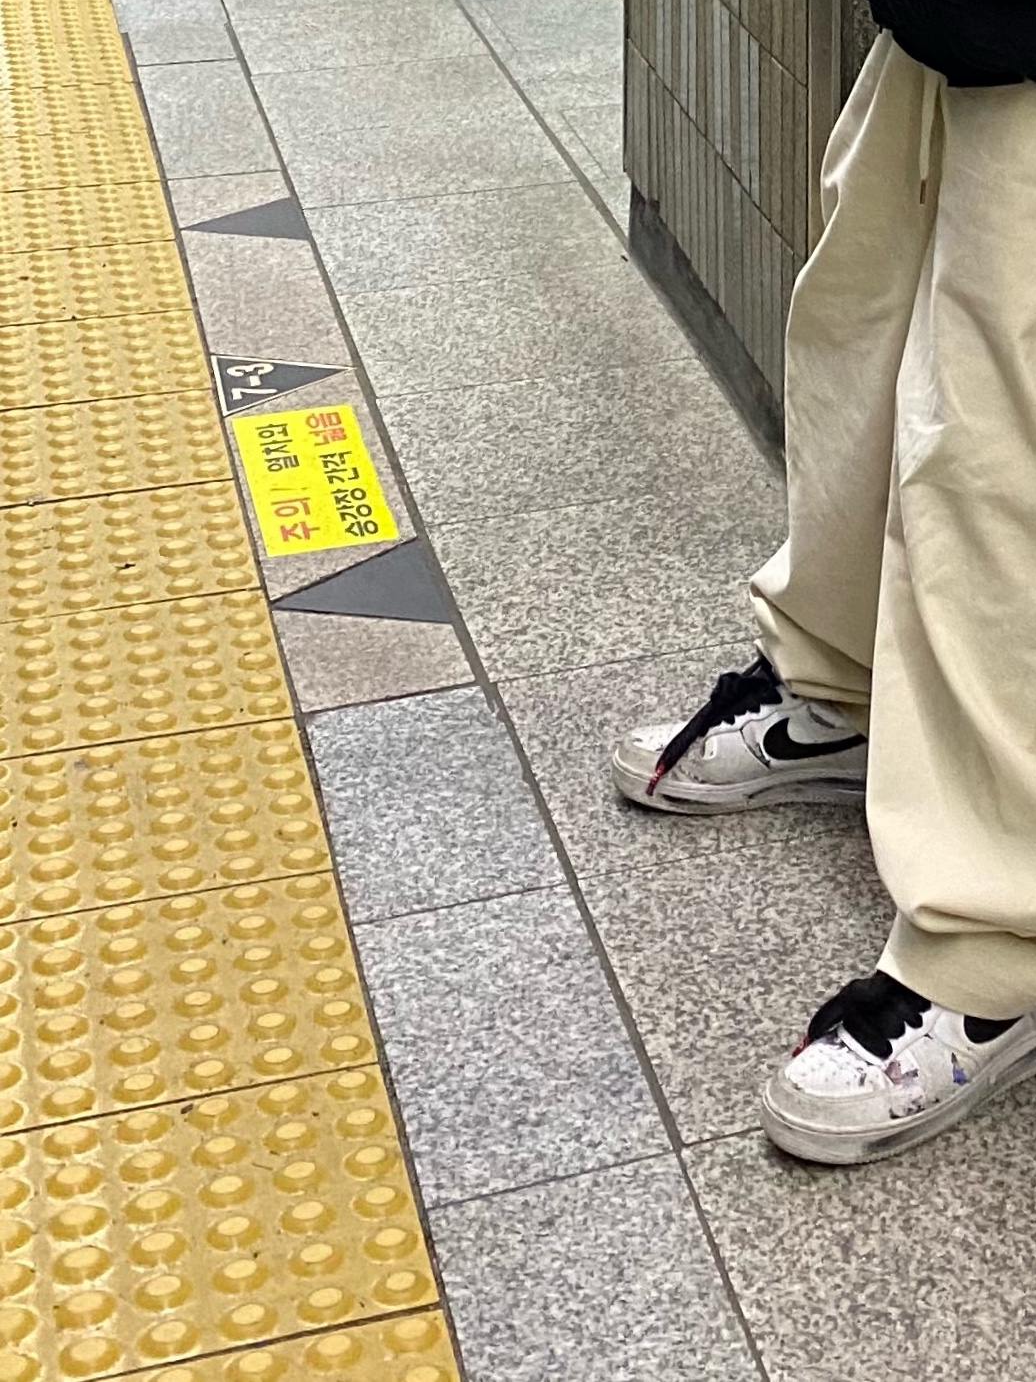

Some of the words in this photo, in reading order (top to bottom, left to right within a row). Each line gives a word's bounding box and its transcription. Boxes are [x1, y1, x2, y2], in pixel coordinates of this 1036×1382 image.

[226, 362, 278, 401] 7-3
[255, 422, 300, 473] 열차와
[305, 411, 348, 447] 넓음
[318, 450, 360, 485] 간격
[330, 487, 379, 538] 승강장
